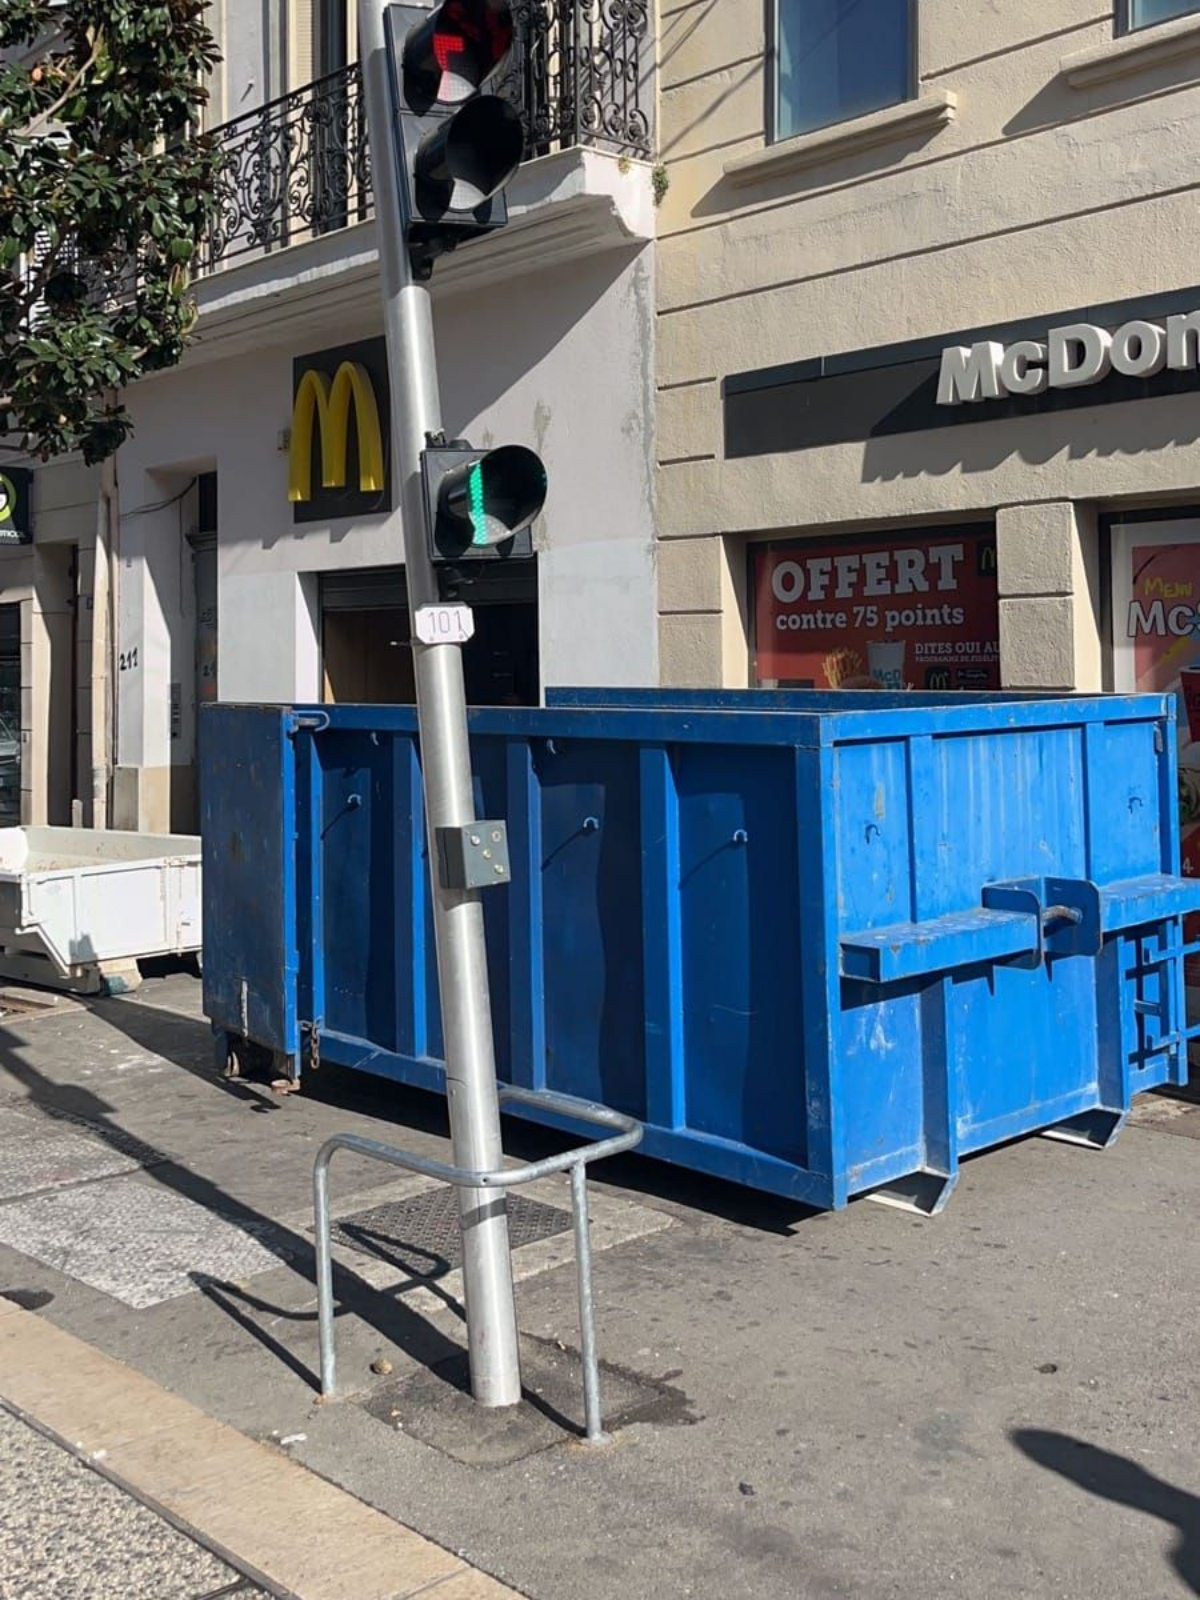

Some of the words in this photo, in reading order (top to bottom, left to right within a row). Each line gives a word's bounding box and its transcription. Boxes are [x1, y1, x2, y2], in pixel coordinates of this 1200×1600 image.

[772, 543, 964, 603] OFFERT
[428, 609, 462, 634] 101
[776, 610, 847, 630] contre
[853, 606, 878, 628] 75
[885, 603, 965, 632] points
[1127, 599, 1200, 637] Mc
[120, 647, 138, 671] 211
[915, 642, 953, 654] DITES
[955, 641, 981, 653] OUI
